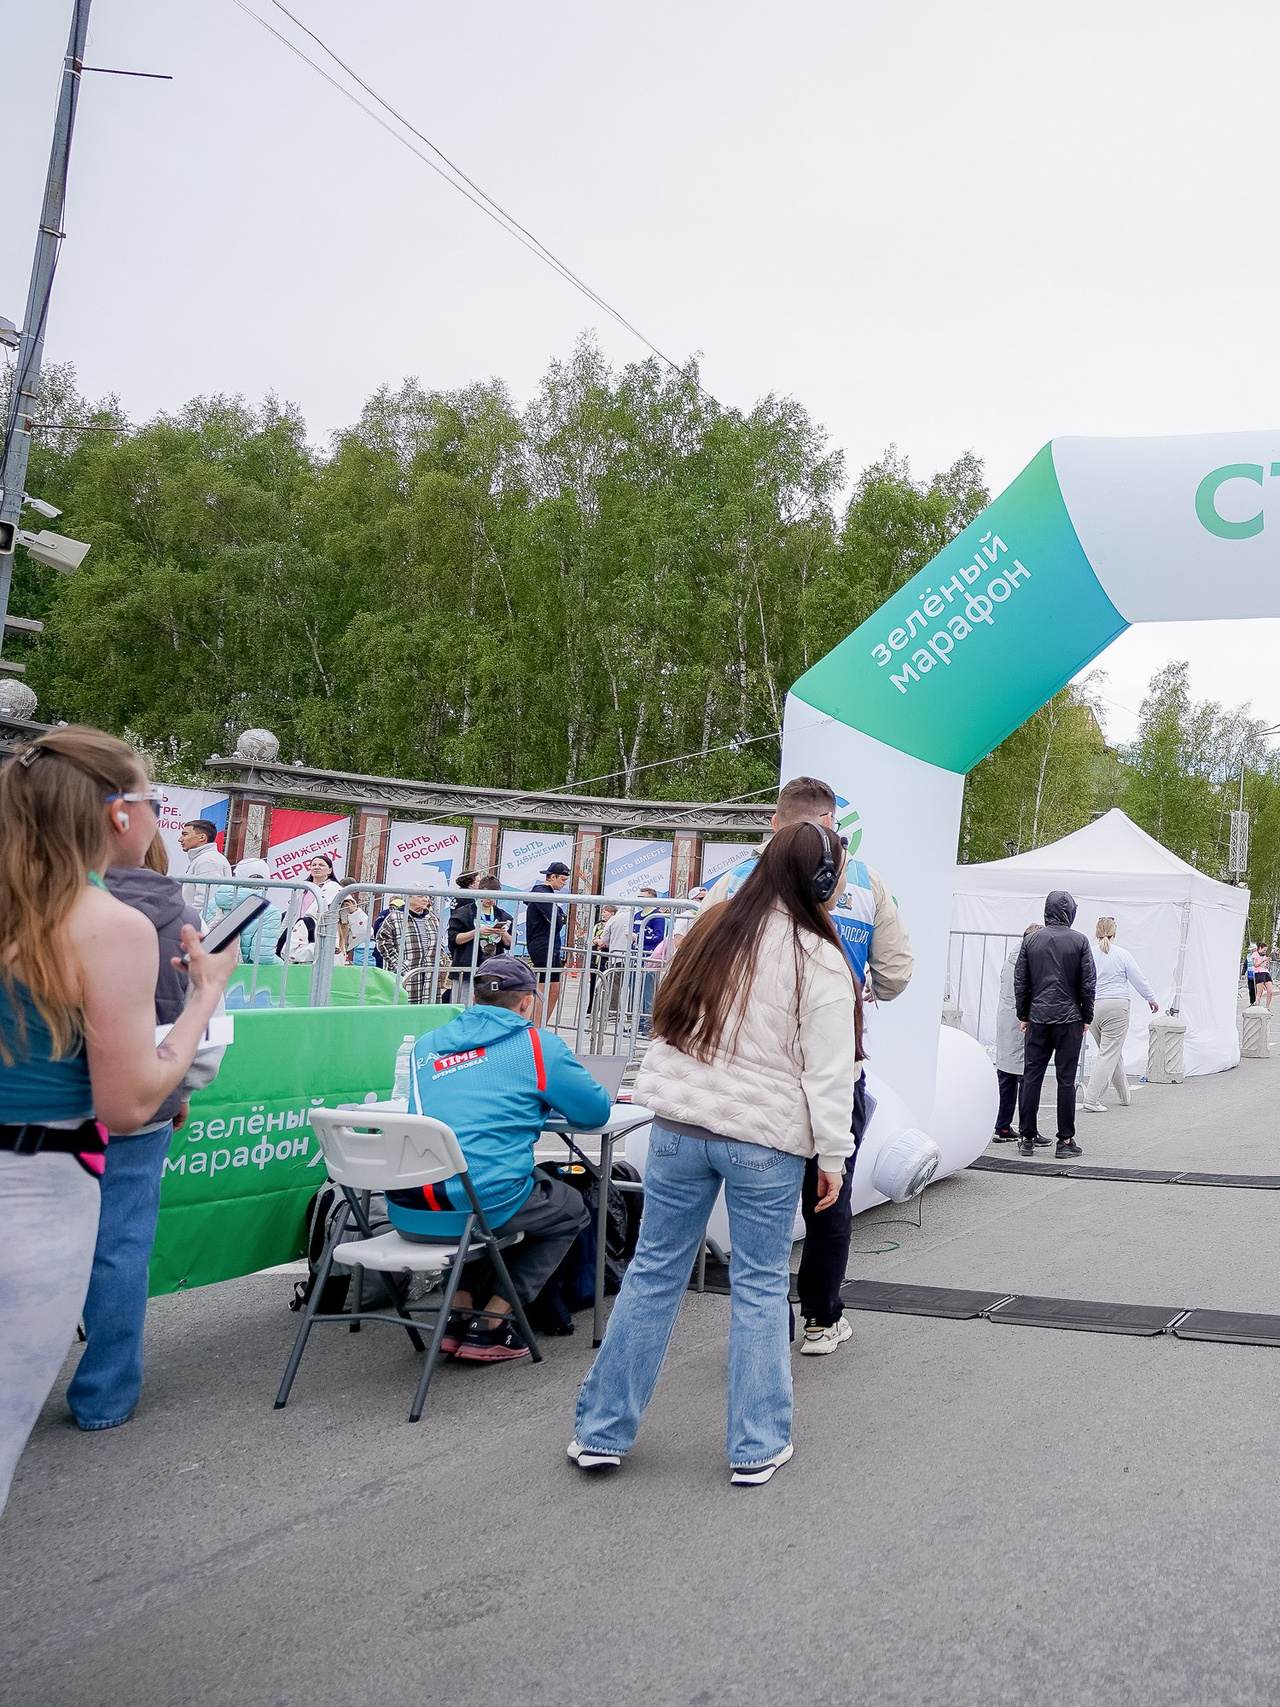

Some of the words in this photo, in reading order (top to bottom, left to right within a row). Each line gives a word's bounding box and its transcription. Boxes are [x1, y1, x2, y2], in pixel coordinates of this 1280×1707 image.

[870, 530, 1009, 667] зелёный
[888, 559, 1032, 694] марафон
[274, 834, 341, 868] ДВИЖЕНИЕ
[392, 858, 402, 867] С
[403, 834, 460, 863] РОССИЕЙ
[397, 835, 431, 853] БЫТЬ
[506, 862, 515, 870] В
[516, 839, 568, 867] ДВИЖЕНИИ
[512, 840, 544, 857] БЫТЬ
[610, 861, 634, 876] БЫТЬ
[634, 846, 667, 866] ВМЕСТЕ
[707, 850, 749, 876] ФЕСТИВАЛЬ
[626, 874, 665, 895] РОССИЕЙ
[627, 872, 650, 887] БЫТЬ
[439, 1049, 479, 1068] TIME
[431, 1067, 457, 1081] ВРЕМЯ
[160, 1135, 309, 1179] марафон
